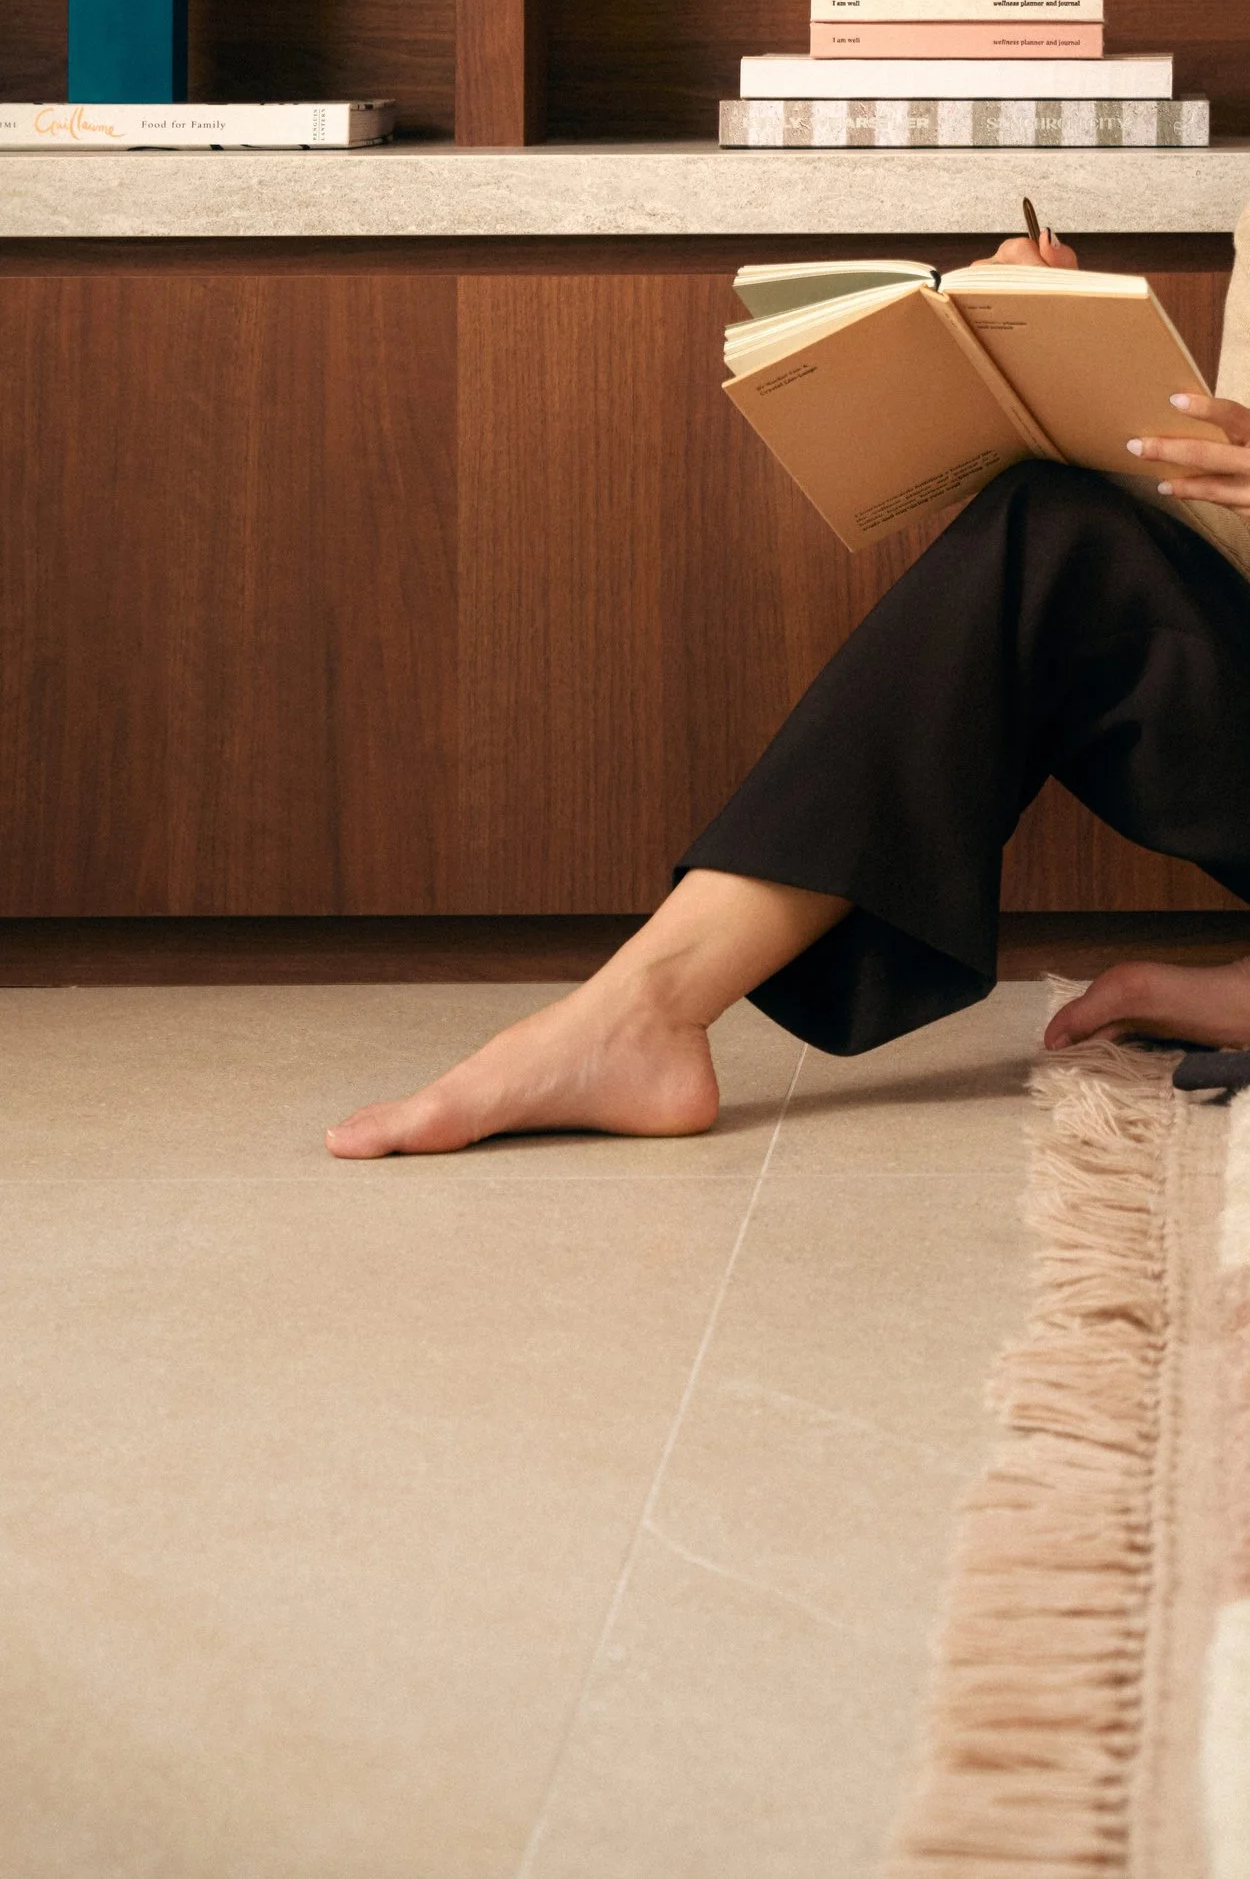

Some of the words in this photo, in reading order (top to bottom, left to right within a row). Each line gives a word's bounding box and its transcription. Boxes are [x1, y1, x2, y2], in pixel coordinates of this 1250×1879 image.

[1058, 0, 1081, 8] journal
[34, 106, 126, 140] Guillaume
[141, 120, 167, 129] Food
[171, 120, 187, 129] for
[191, 120, 226, 131] Family
